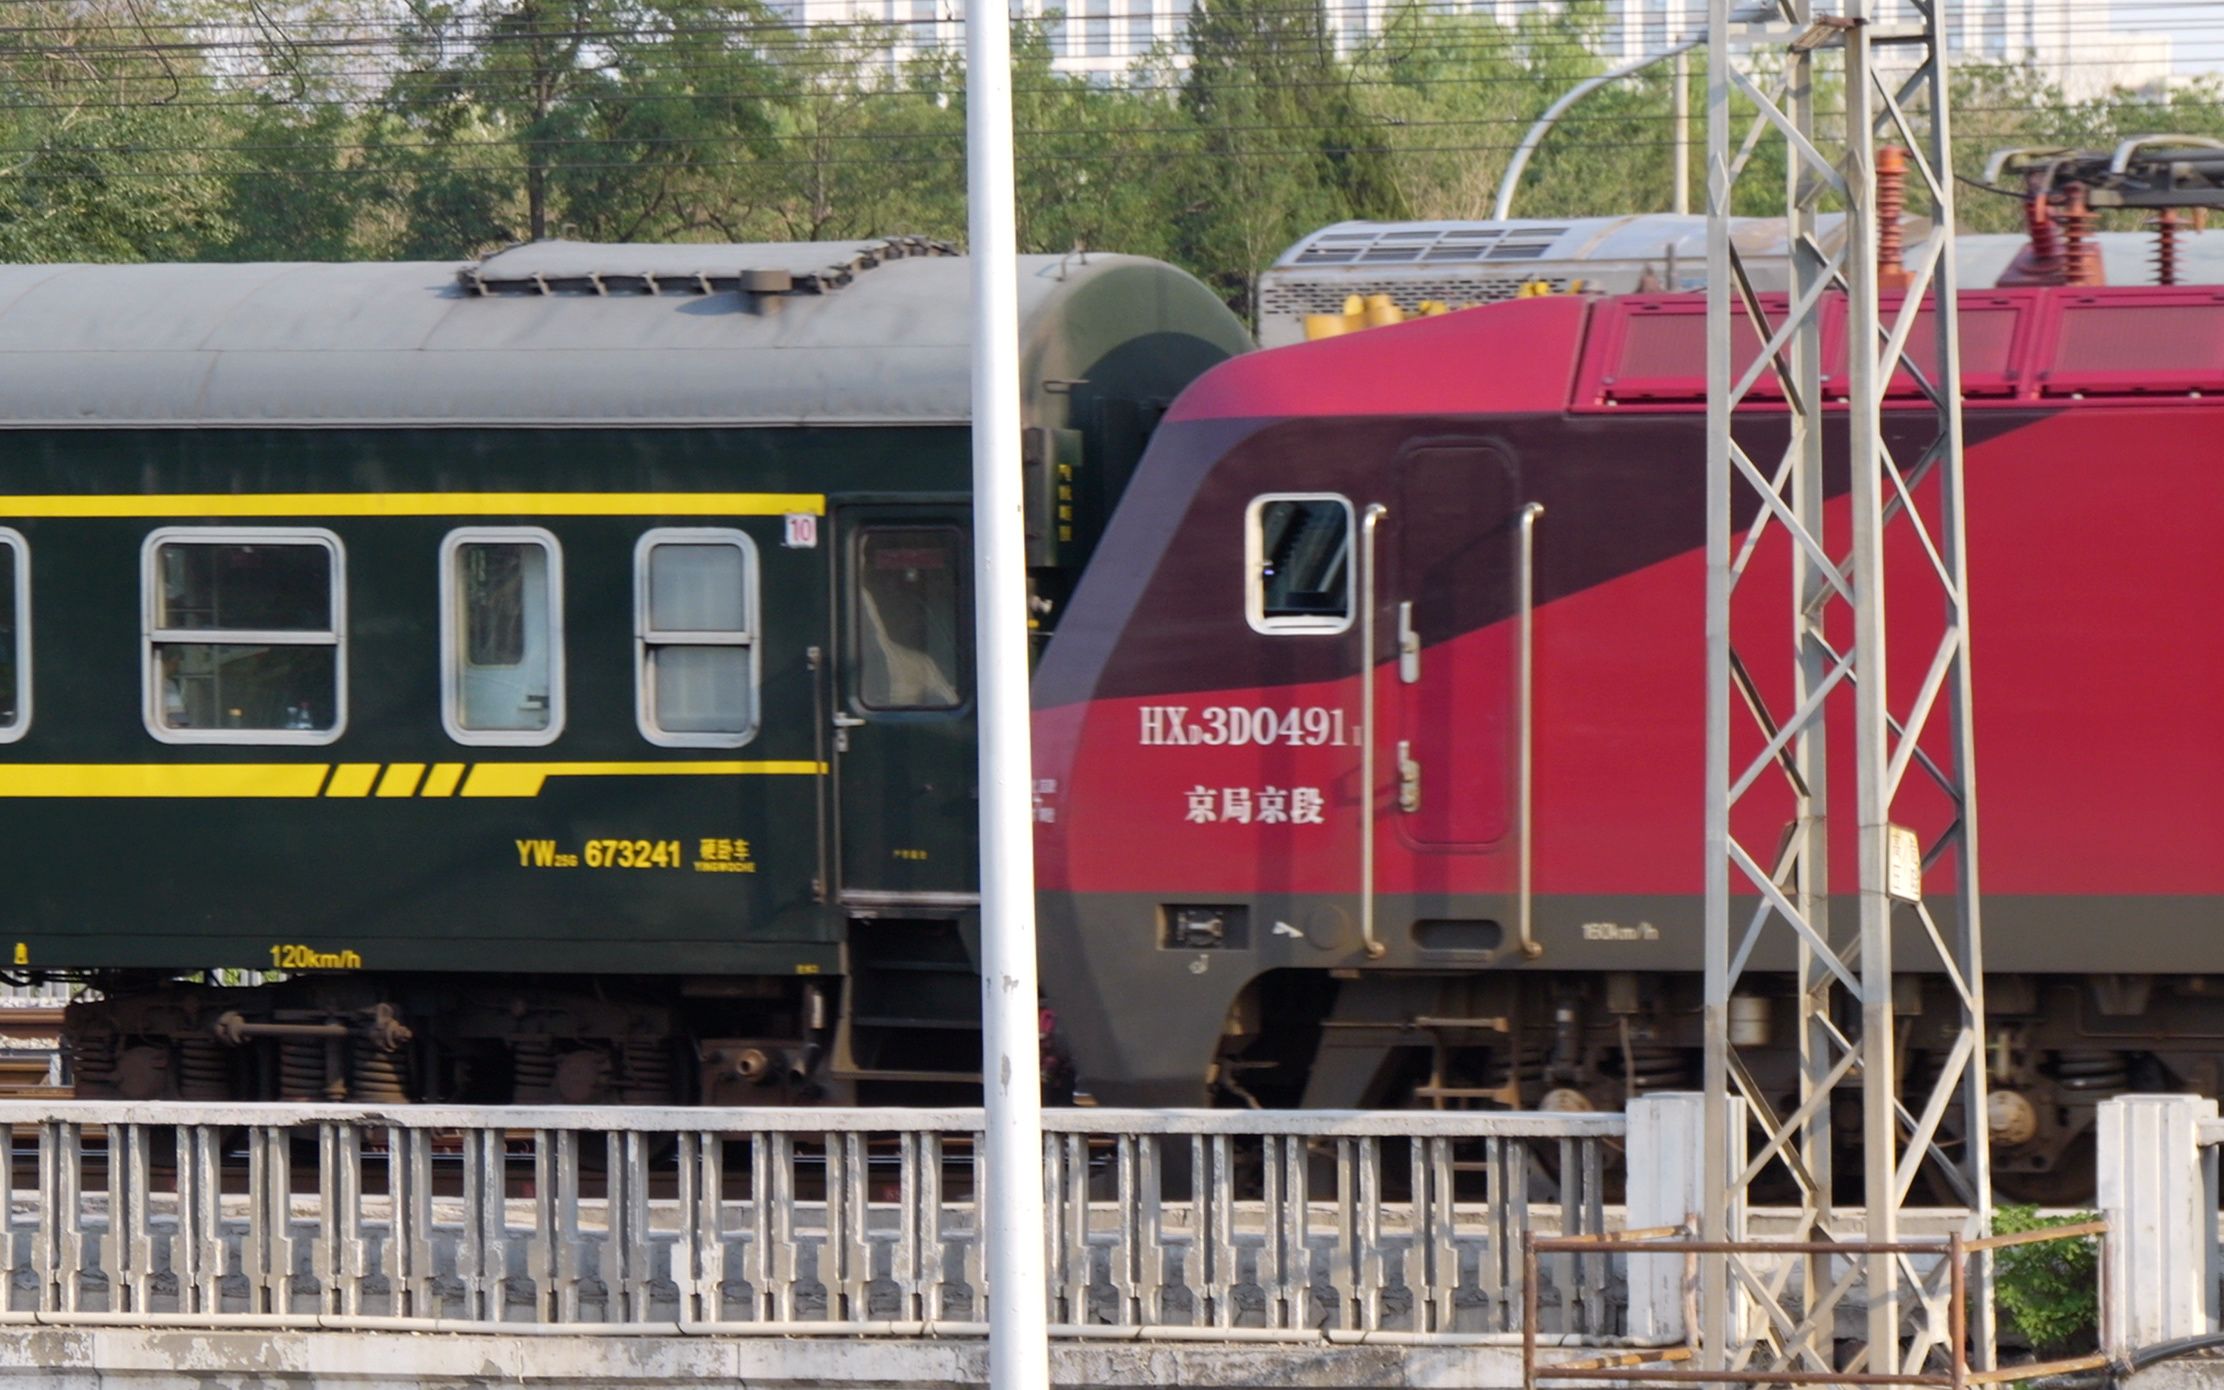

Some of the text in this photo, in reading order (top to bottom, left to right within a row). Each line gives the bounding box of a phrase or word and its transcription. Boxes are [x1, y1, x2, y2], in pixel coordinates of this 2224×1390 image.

[791, 518, 813, 542] 10
[1184, 785, 1325, 824] 京局京段
[585, 840, 681, 868] 673241
[1582, 921, 1660, 940] 160km/h
[270, 945, 361, 968] 120km/h
